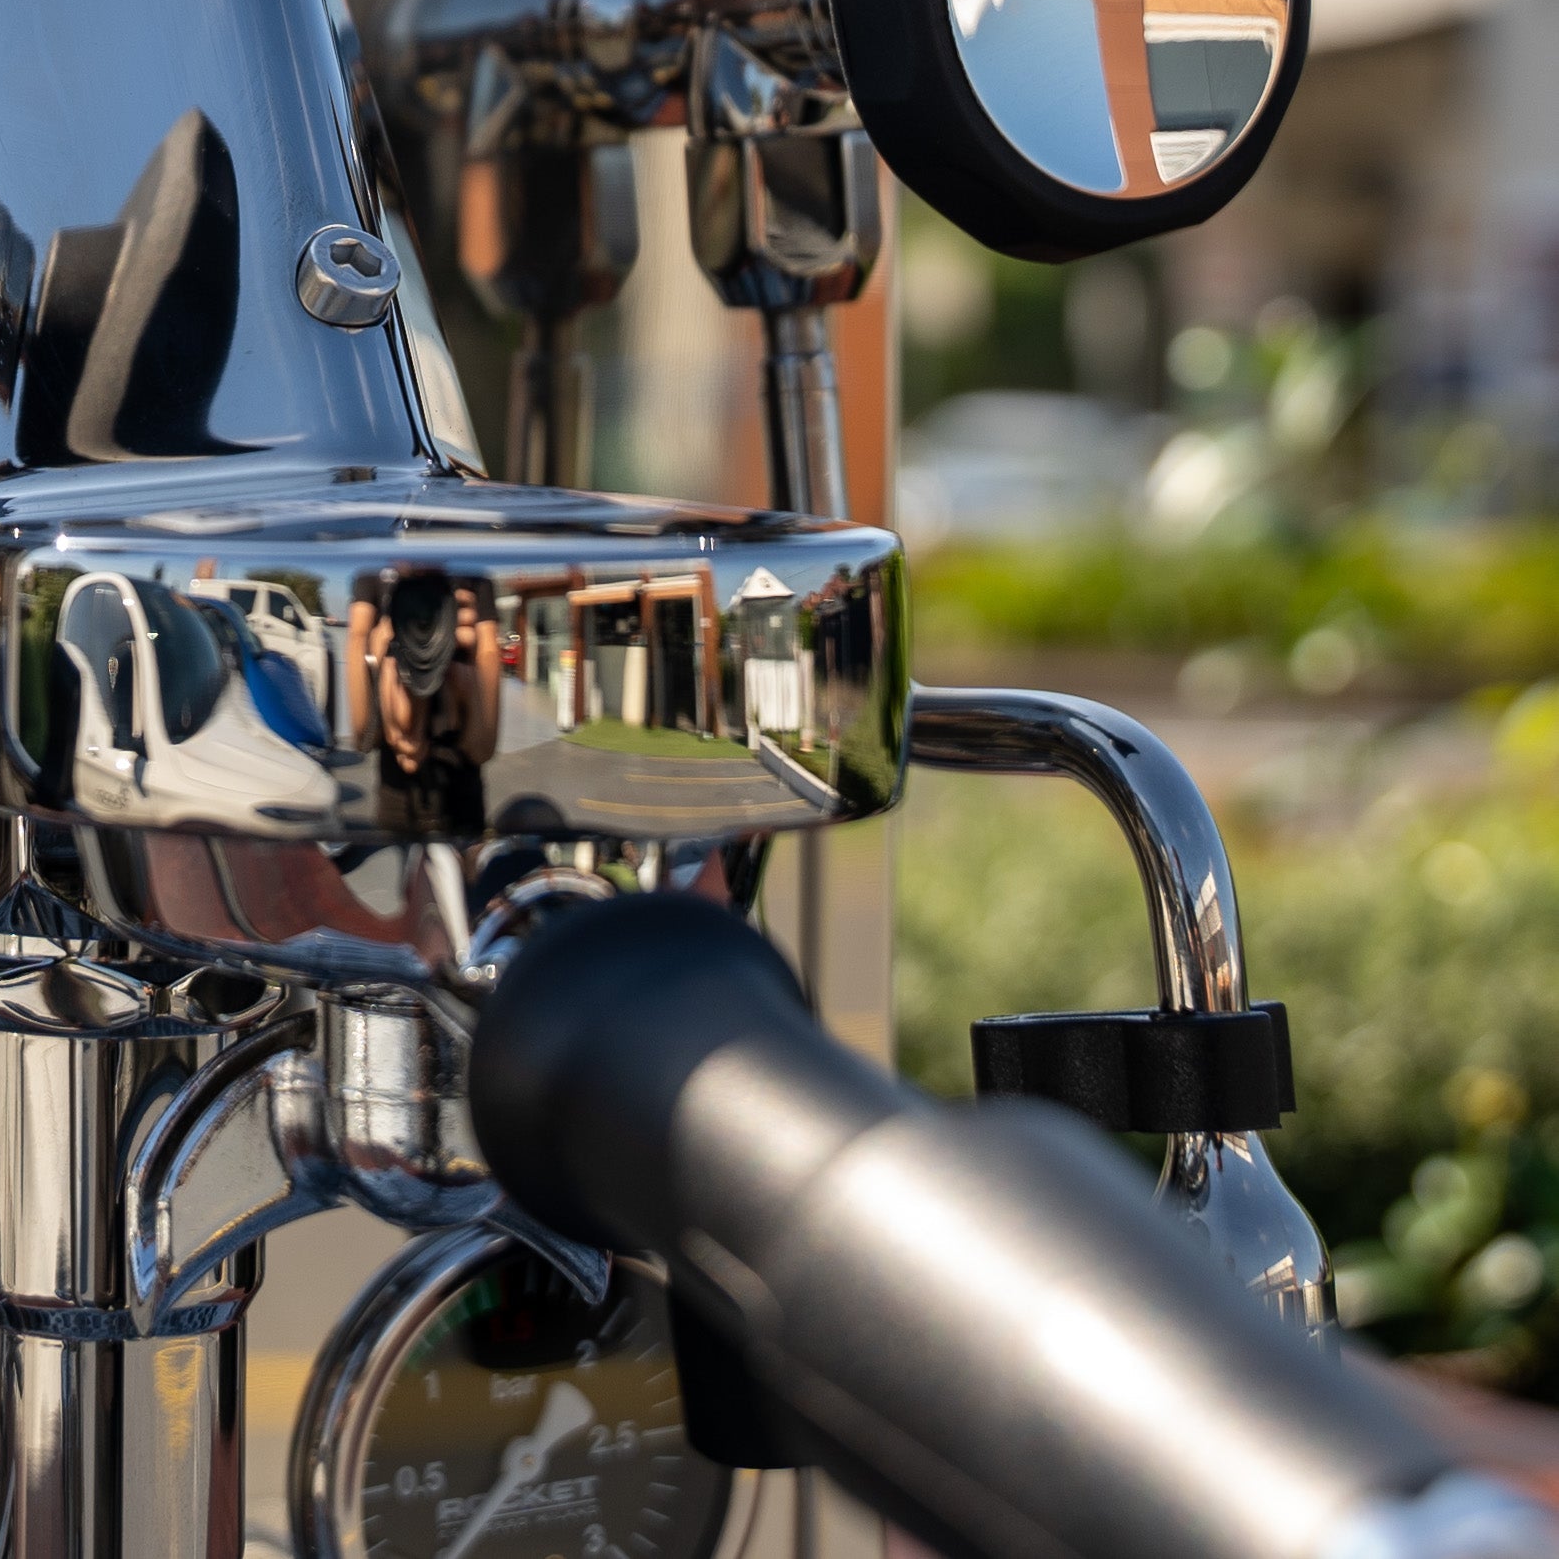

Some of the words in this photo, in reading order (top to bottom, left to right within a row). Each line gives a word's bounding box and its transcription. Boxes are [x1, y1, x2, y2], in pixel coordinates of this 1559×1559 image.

[575, 1338, 599, 1369] 2
[589, 1419, 639, 1456] 2.5
[395, 1461, 447, 1495] 0.5
[583, 1524, 607, 1553] 3
